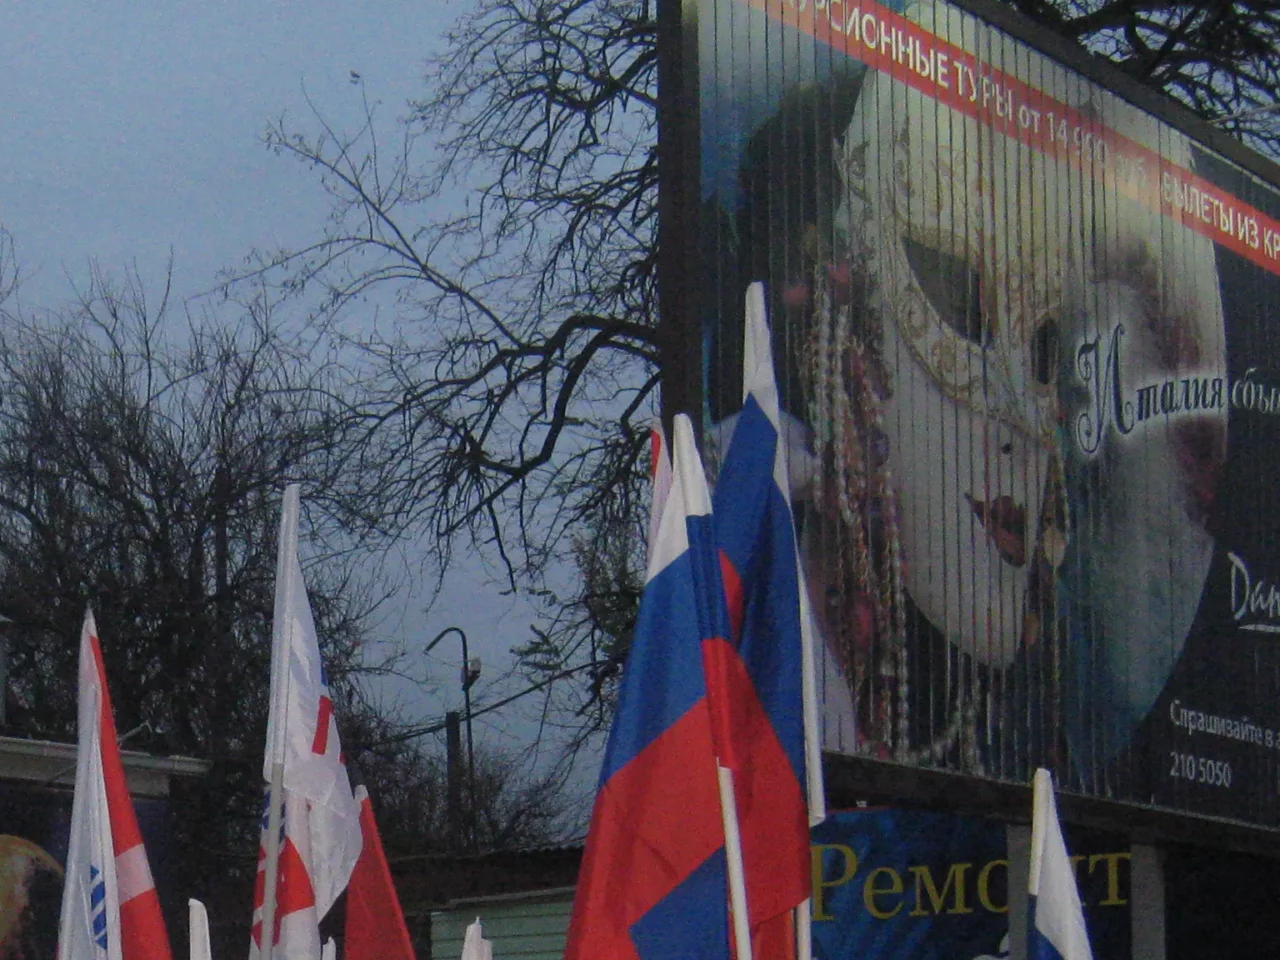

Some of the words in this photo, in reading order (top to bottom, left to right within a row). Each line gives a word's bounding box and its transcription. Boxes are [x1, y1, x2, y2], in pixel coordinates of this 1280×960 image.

[953, 60, 1014, 122] ТУРЫ
[1046, 111, 1067, 149] 14
[1163, 171, 1234, 236] ВЫЛЕТЫ
[1237, 212, 1260, 249] ИЗ
[1077, 323, 1225, 454] Италия
[1169, 698, 1263, 746] Спрашивайте
[1169, 751, 1195, 781] 210
[1198, 757, 1232, 789] 5050
[810, 842, 1131, 922] Ремот
